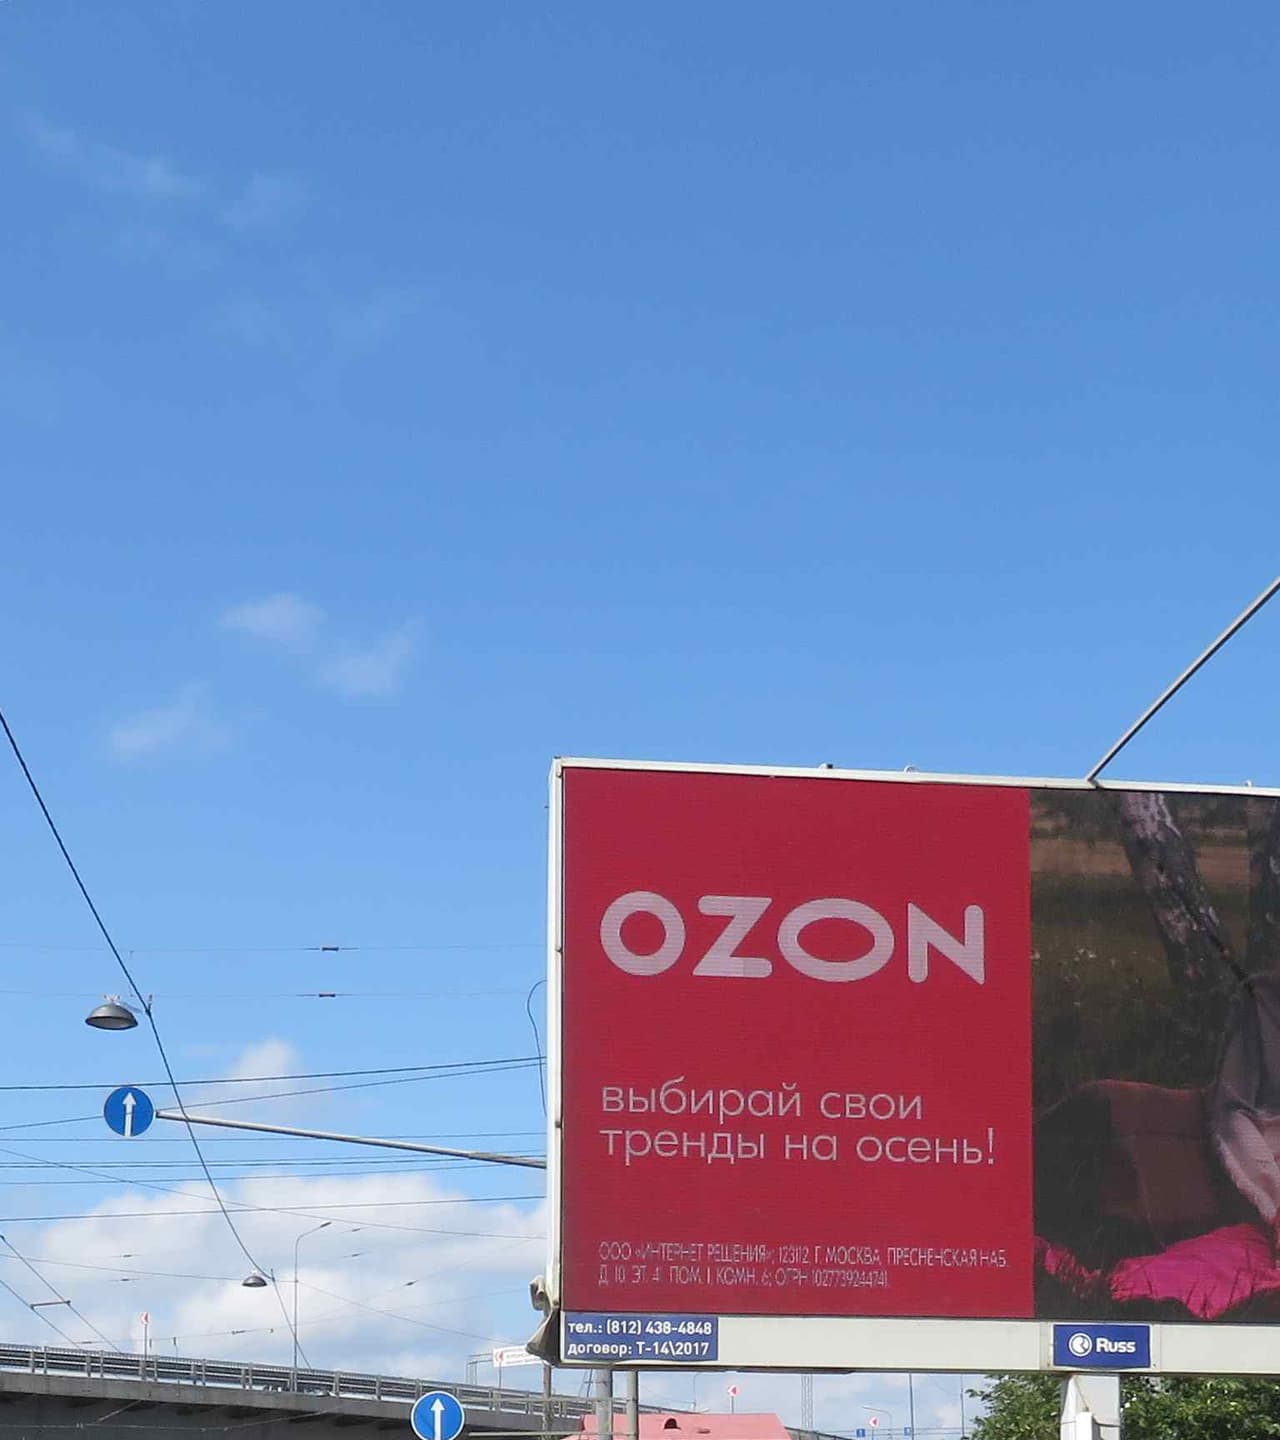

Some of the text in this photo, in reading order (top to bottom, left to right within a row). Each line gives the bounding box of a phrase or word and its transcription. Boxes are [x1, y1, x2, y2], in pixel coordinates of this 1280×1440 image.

[600, 890, 985, 984] OZON
[601, 1076, 923, 1125] выбирай свои
[599, 1127, 994, 1165] тренды на осень!
[598, 1241, 632, 1261] ООО
[567, 1319, 713, 1336] тел.: (812) 438-4848
[567, 1341, 710, 1358] договор: Т-14\2017
[1096, 1337, 1136, 1353] Russ
